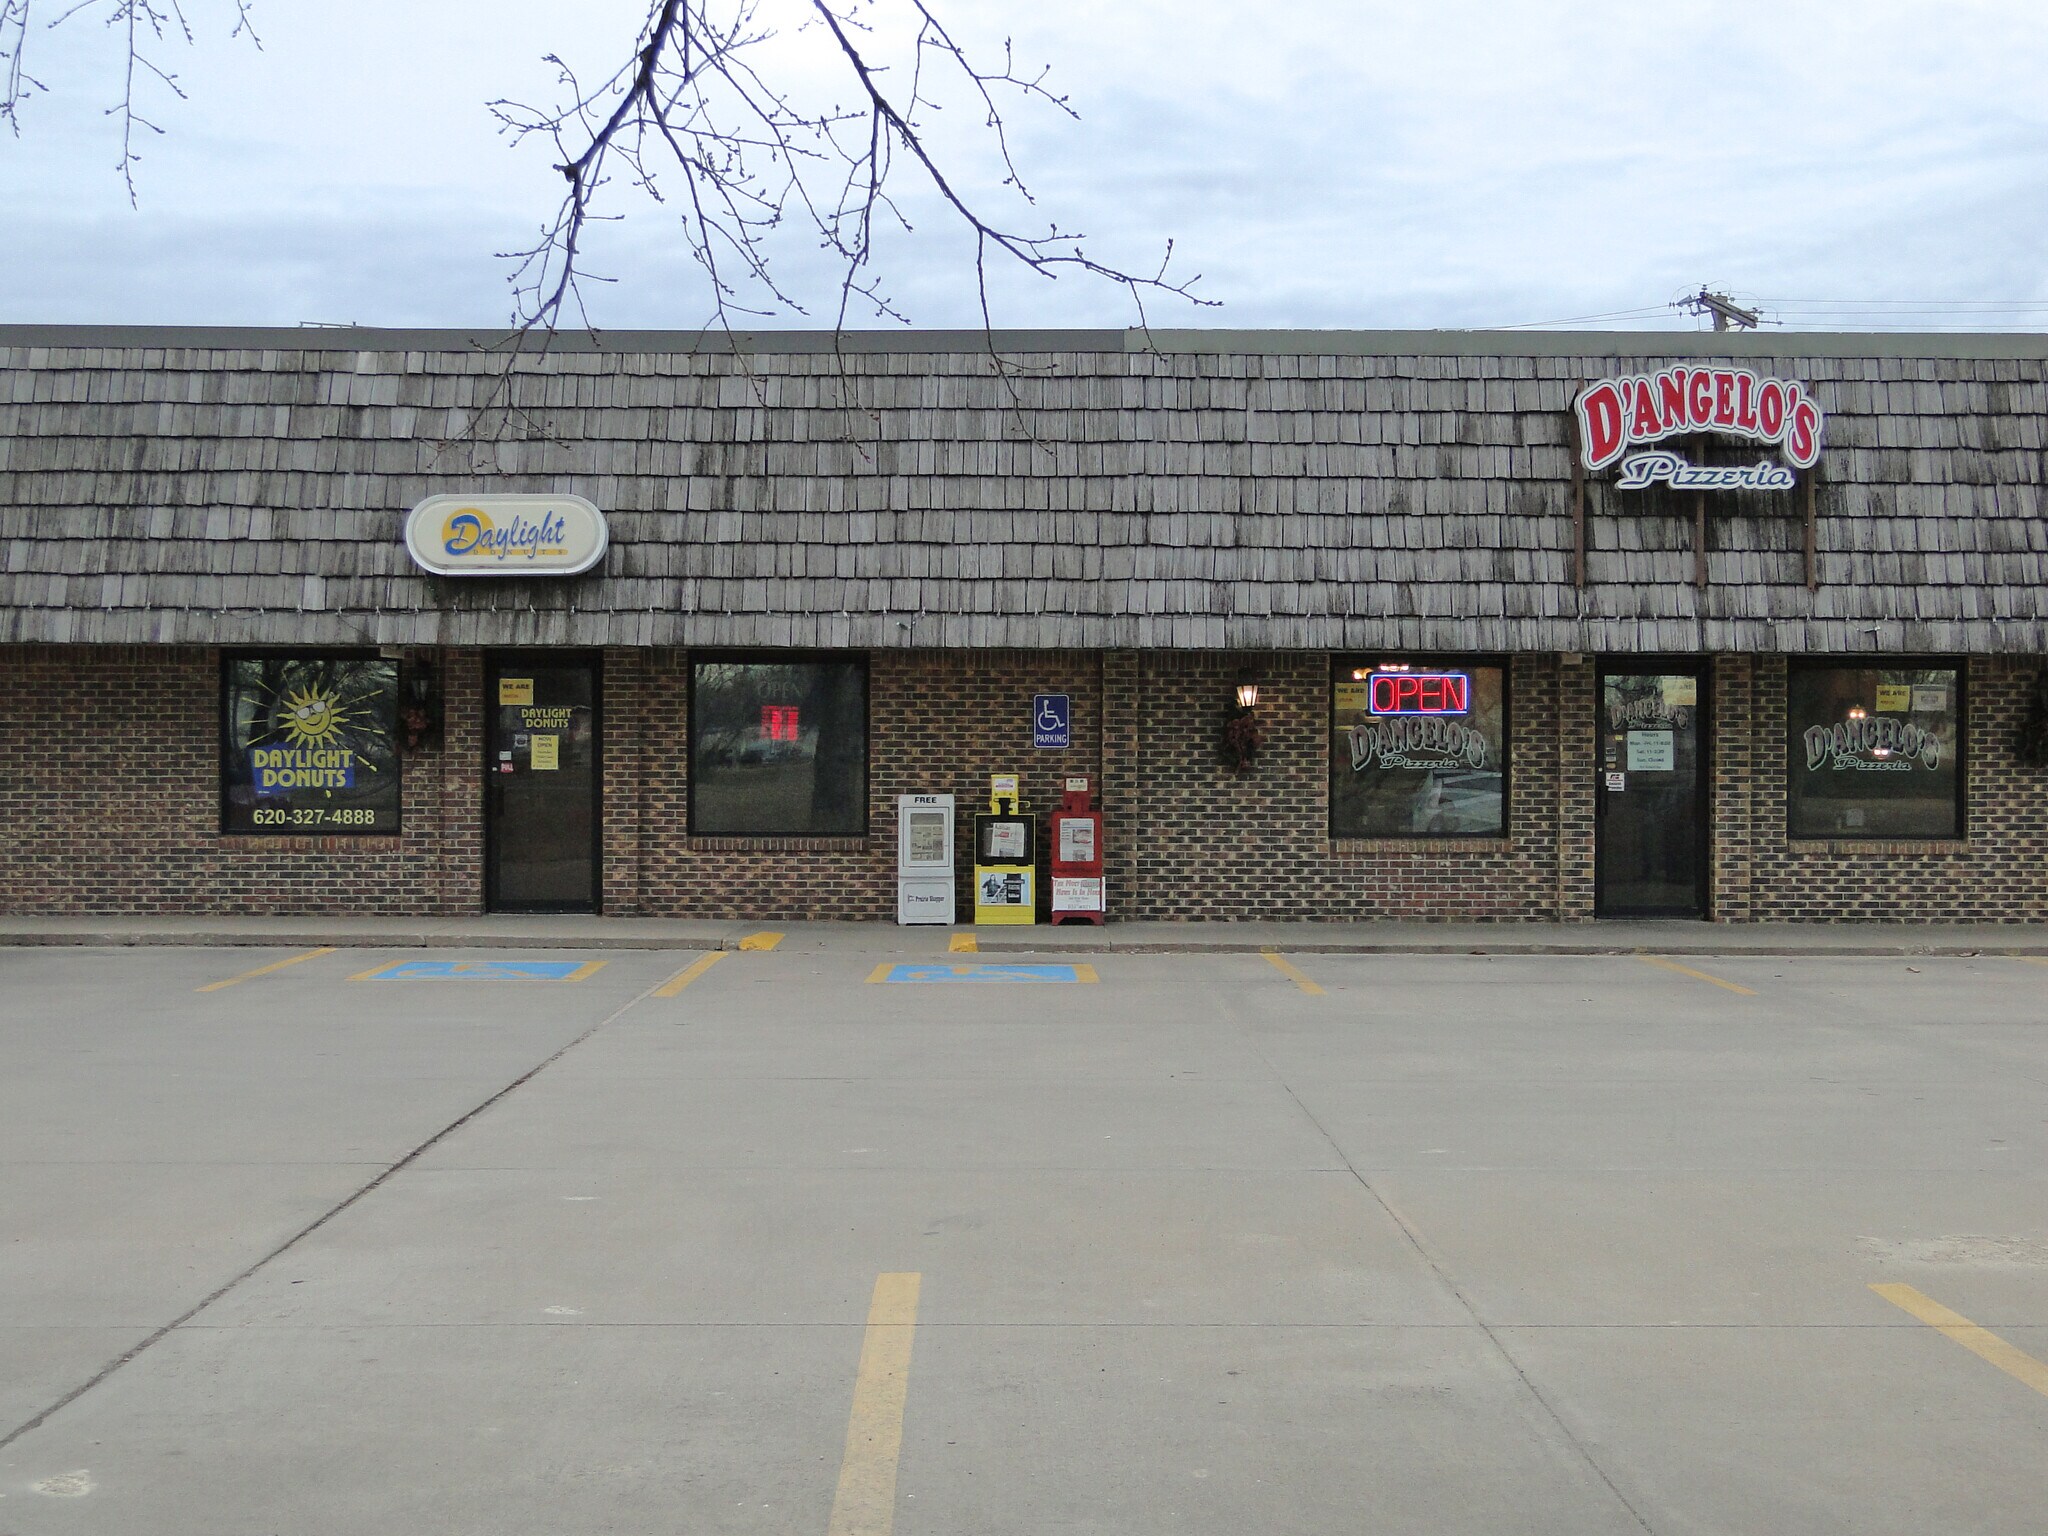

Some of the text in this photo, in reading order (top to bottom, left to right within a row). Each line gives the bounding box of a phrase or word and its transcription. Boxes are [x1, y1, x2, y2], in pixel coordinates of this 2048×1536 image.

[1582, 369, 1818, 464] D'ANGELO'S
[1618, 454, 1792, 485] Pizzeria
[444, 510, 566, 560] Daylight
[1373, 677, 1465, 711] OPEN
[521, 708, 573, 718] DAYLIGHT
[525, 718, 569, 728] DONUTS
[1036, 734, 1067, 743] PARKING
[1349, 716, 1486, 771] D'ANGELO'S
[1804, 716, 1940, 771] D'ANGELO'S
[254, 749, 353, 768] DAYLIGHT
[1379, 755, 1459, 769] Pizzeria
[1833, 755, 1912, 771] Pizzeria
[262, 769, 347, 787] DONUTS
[914, 796, 937, 804] FREE
[253, 809, 375, 825] 620-327-4888
